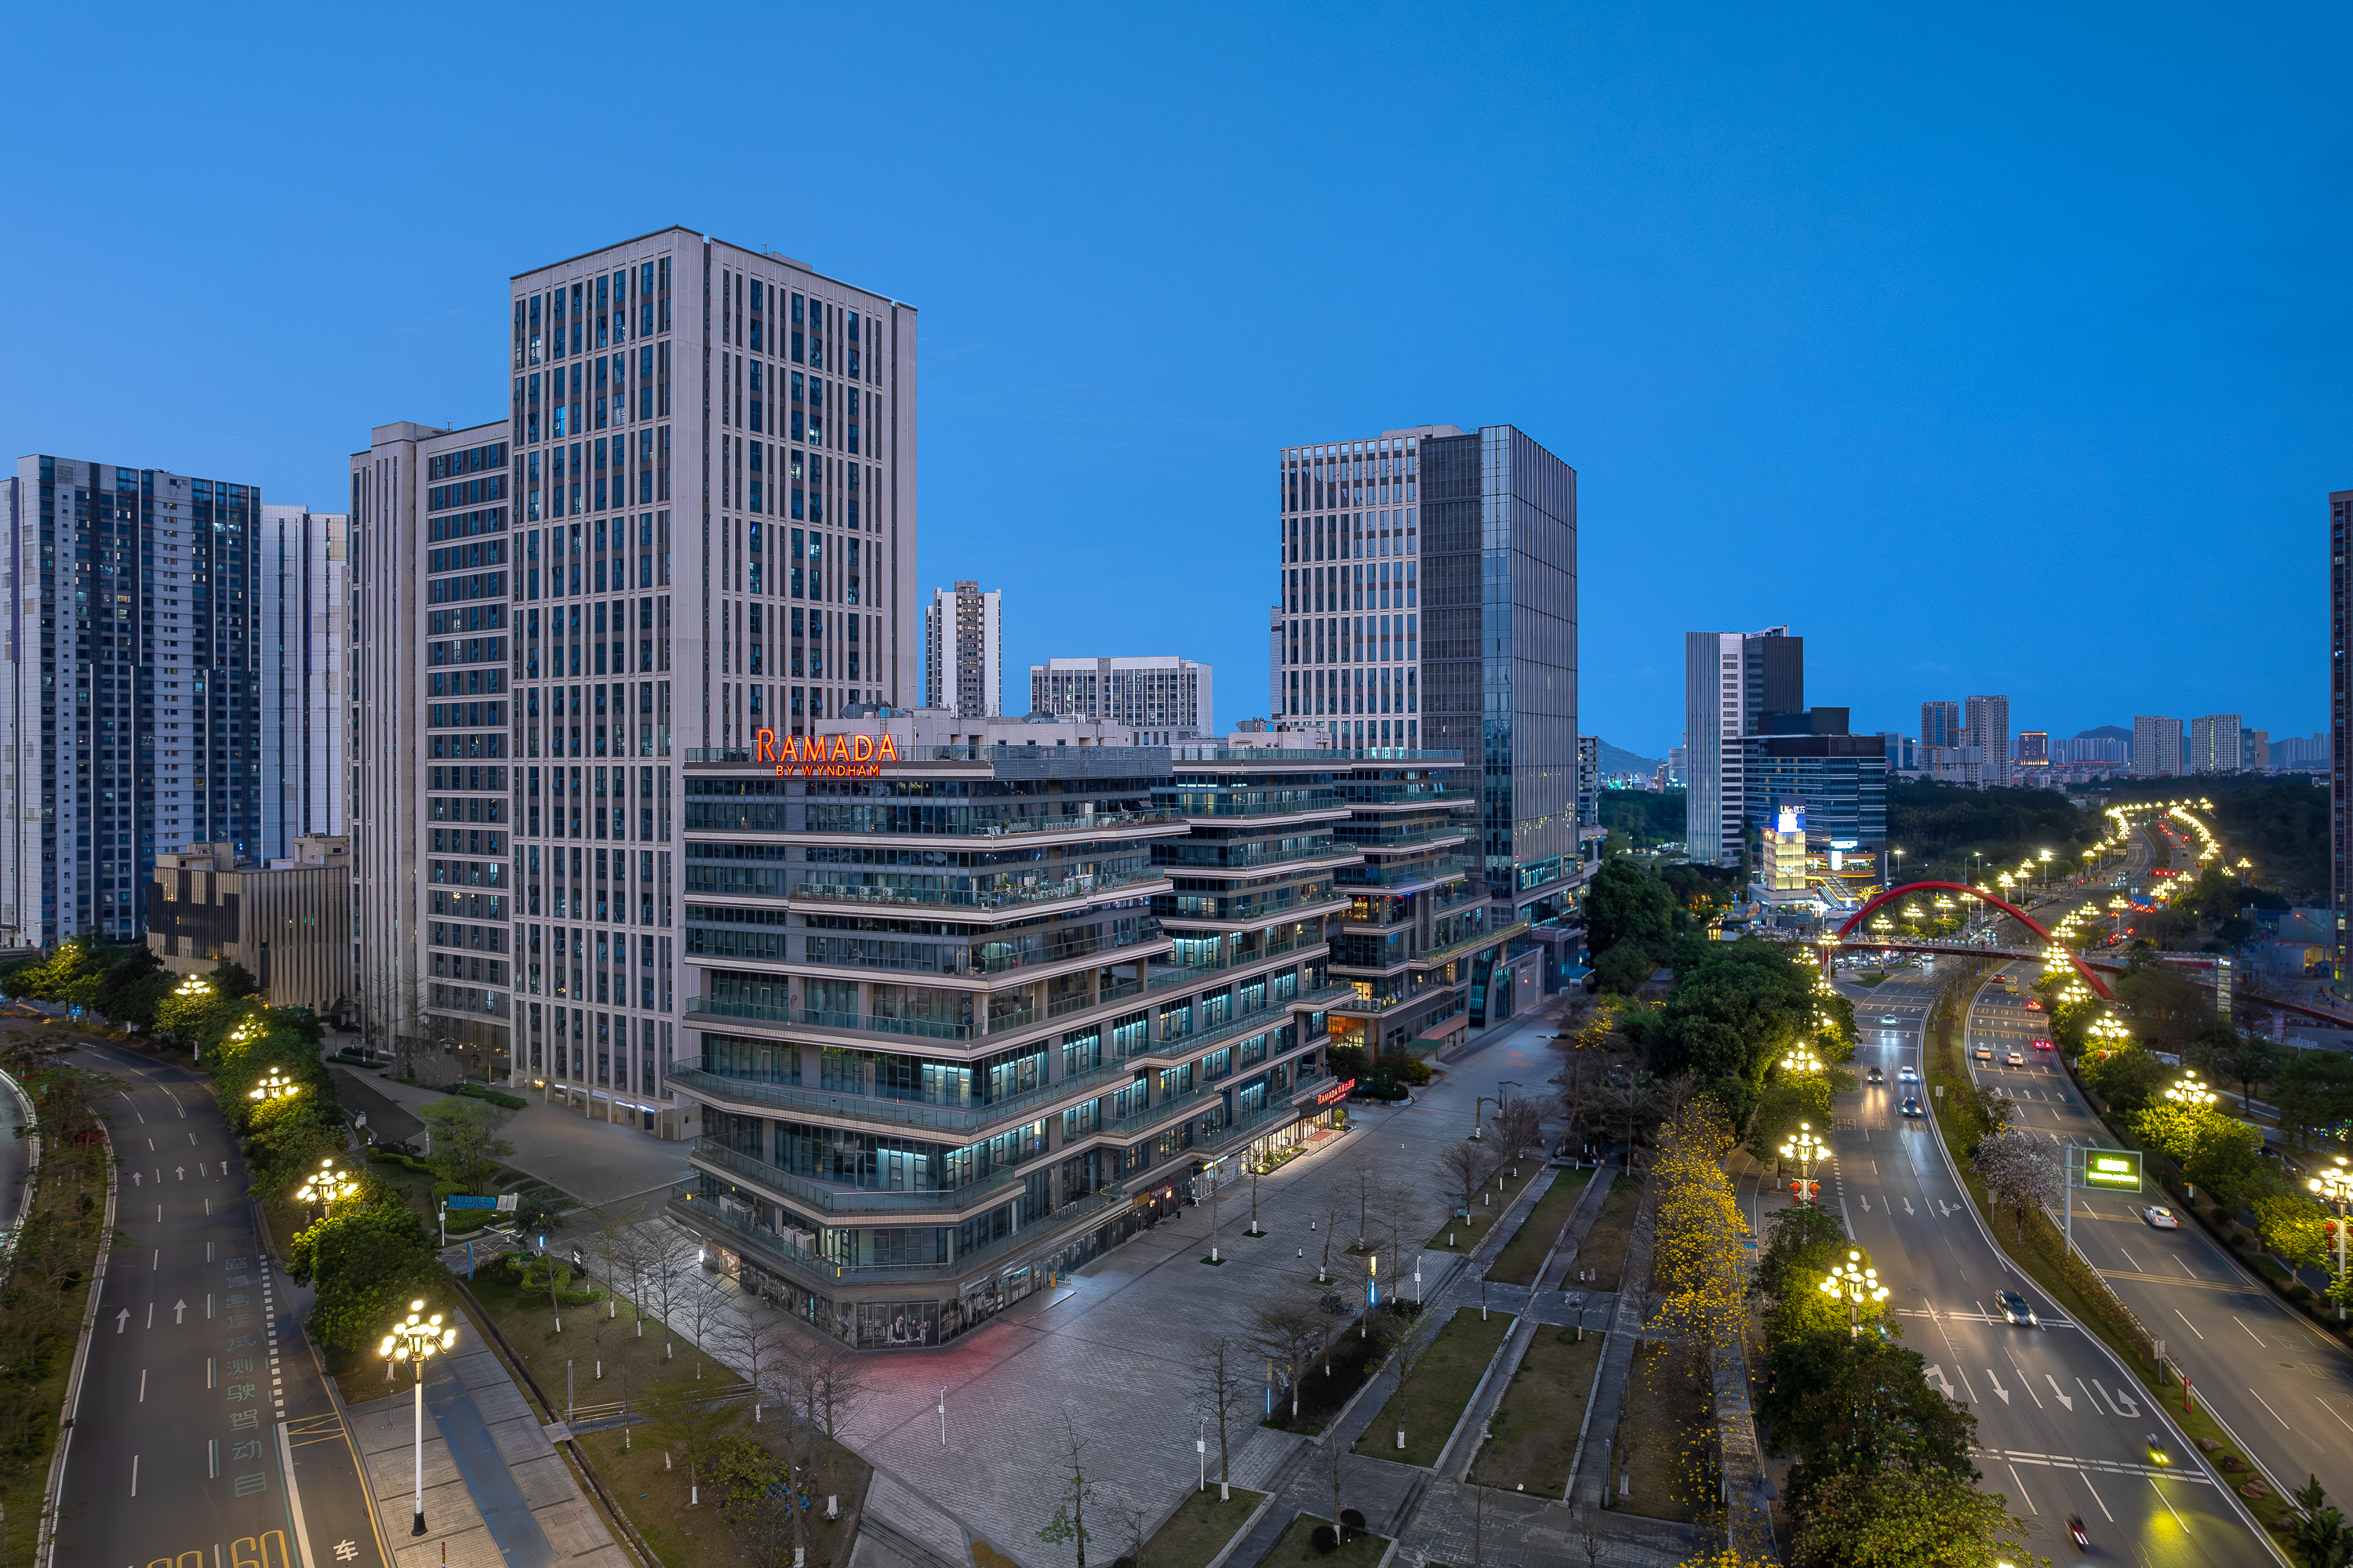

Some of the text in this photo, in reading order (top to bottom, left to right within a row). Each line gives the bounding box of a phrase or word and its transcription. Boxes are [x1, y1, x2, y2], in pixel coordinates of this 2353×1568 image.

[757, 728, 898, 762] RAMADA
[776, 765, 880, 777] BY WYNDHAM
[1318, 1088, 1338, 1105] RAMADA
[333, 1539, 359, 1562] 车
